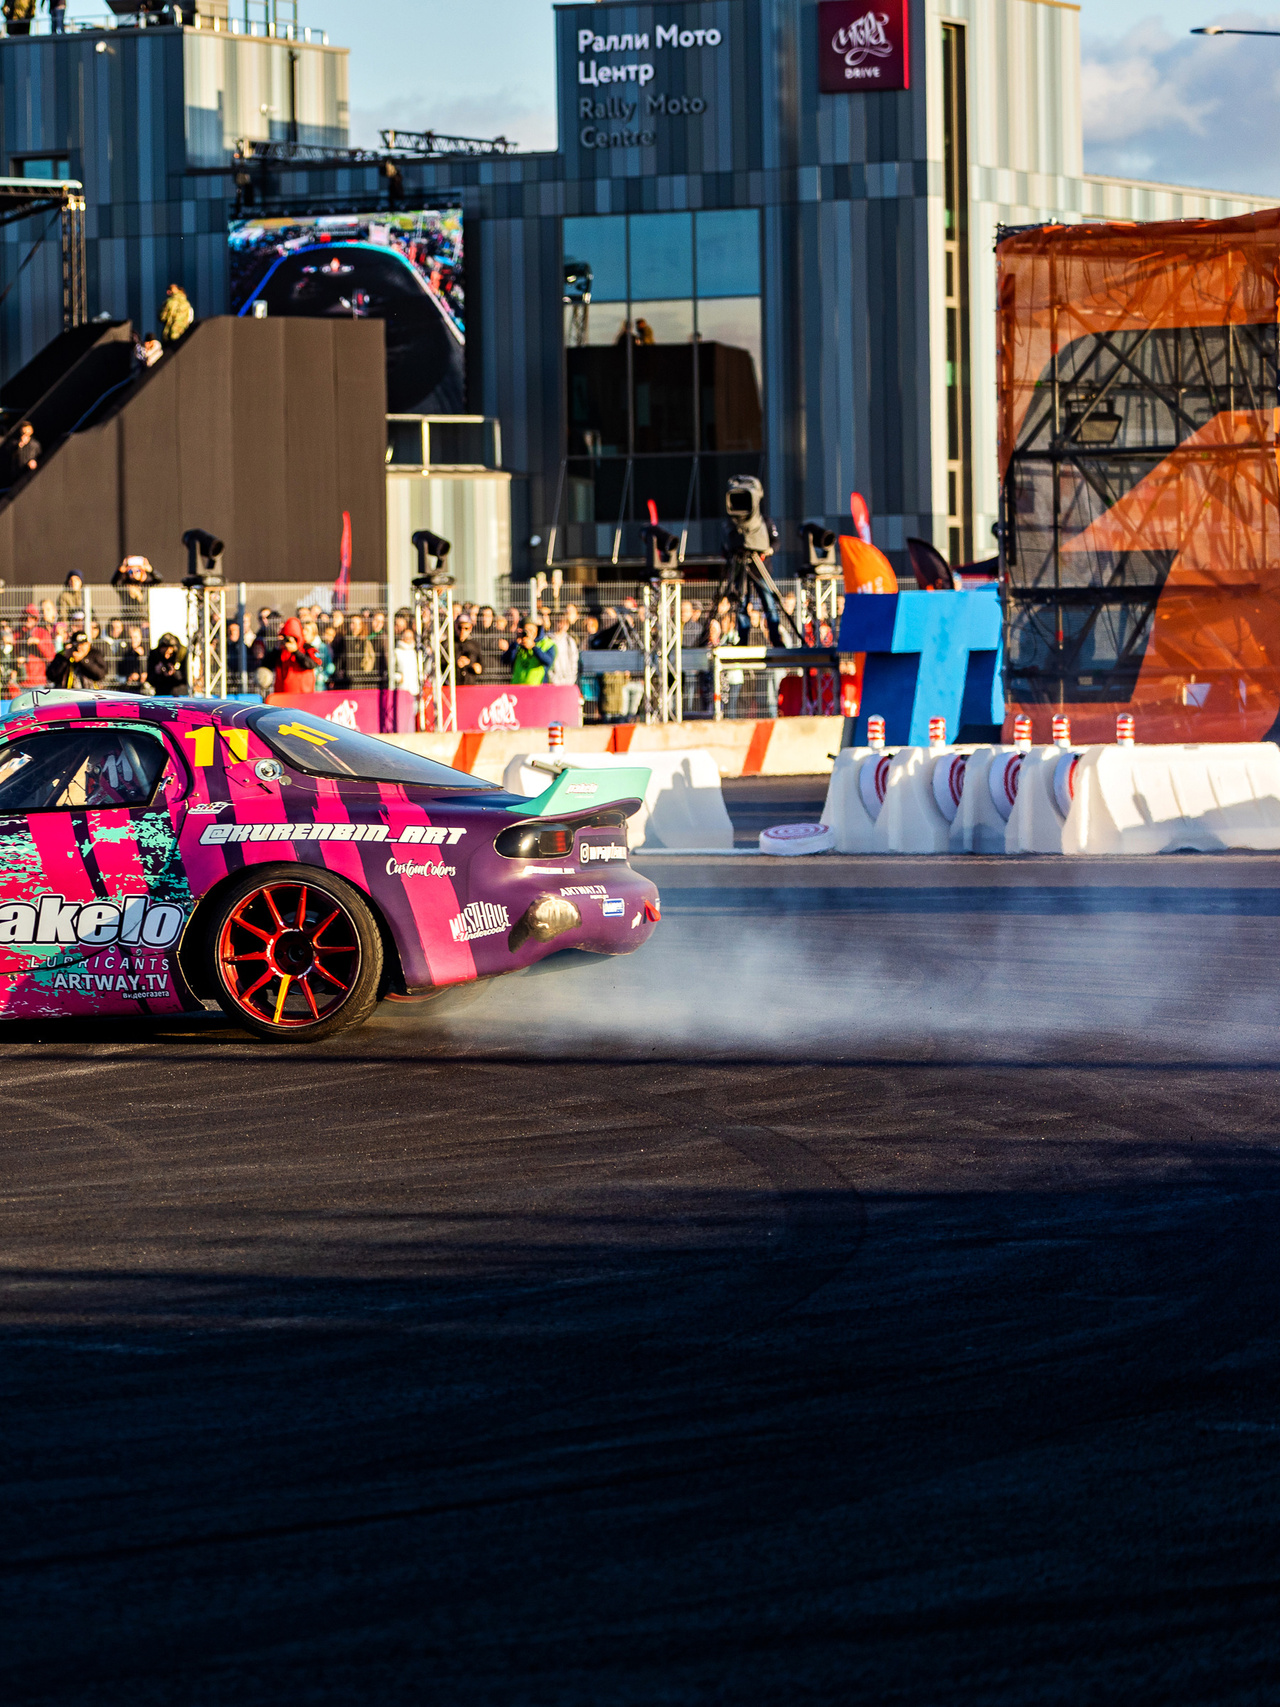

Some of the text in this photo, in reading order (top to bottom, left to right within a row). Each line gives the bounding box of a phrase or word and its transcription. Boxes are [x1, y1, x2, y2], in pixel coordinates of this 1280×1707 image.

[578, 24, 721, 53] Ралли Мото
[578, 60, 655, 87] Центр
[844, 66, 881, 79] DRIVE
[579, 93, 705, 123] Rally Moto
[580, 126, 655, 149] Centre
[277, 721, 340, 746] 11
[184, 726, 249, 767] 11
[559, 885, 607, 897] ARTWAY.TV
[30, 956, 169, 970] LUBRICANTS
[53, 973, 168, 991] ARTWAY.TV
[122, 990, 170, 999] видеогазета
